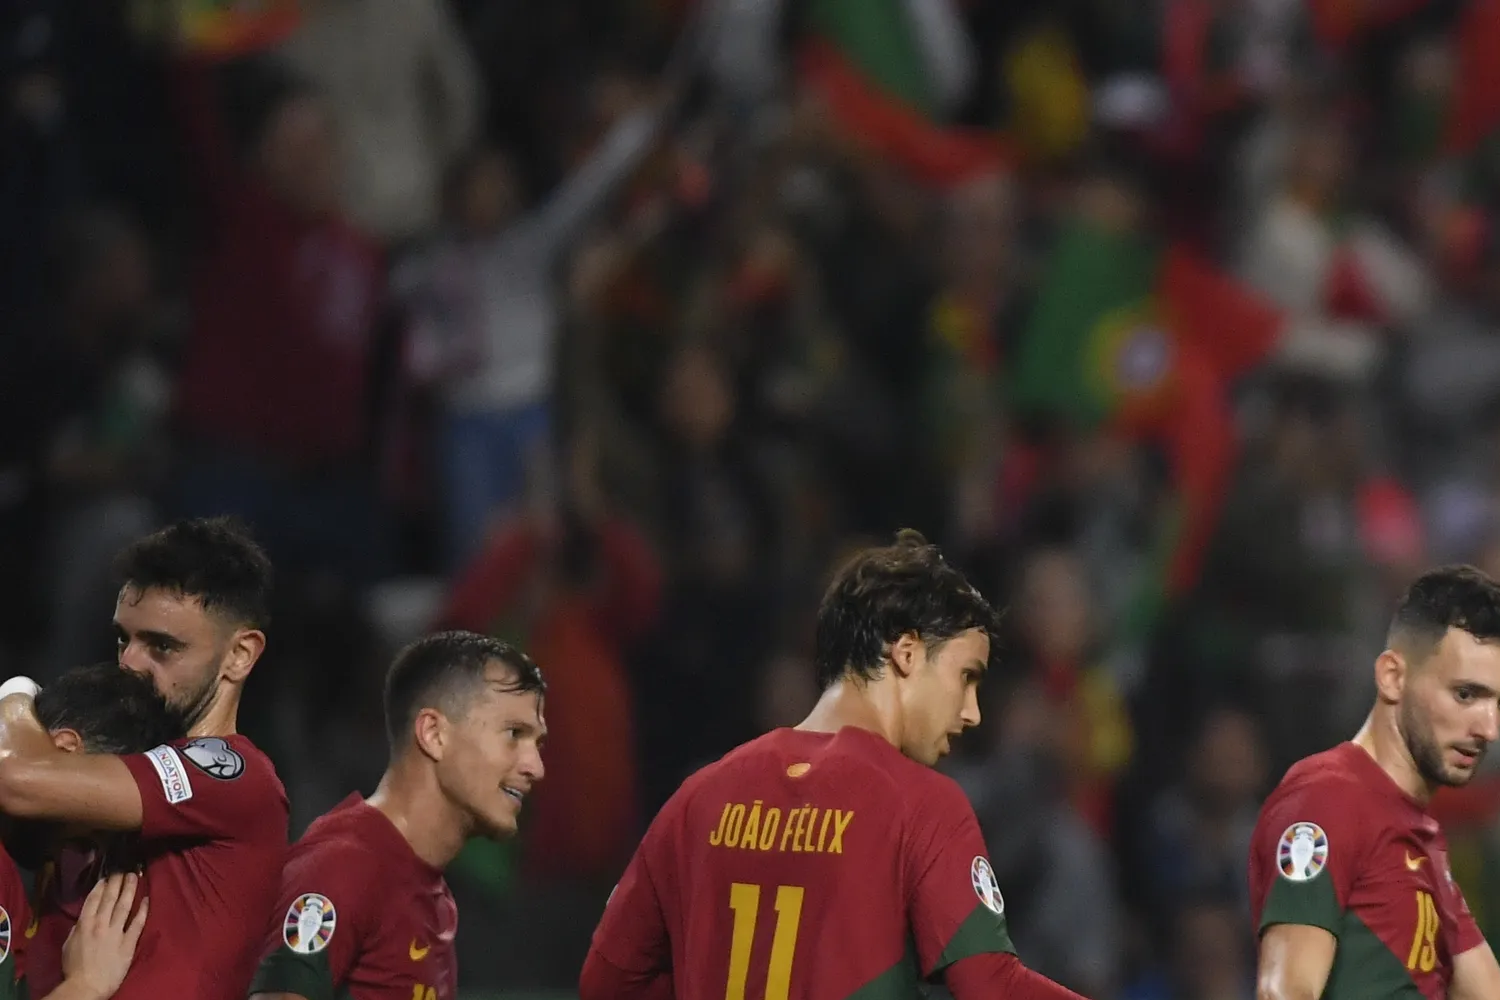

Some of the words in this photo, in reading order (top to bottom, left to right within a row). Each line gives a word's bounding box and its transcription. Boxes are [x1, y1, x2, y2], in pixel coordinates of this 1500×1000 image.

[710, 799, 781, 851] JOÃO
[780, 803, 854, 853] FÉLIX
[1407, 889, 1440, 972] 19
